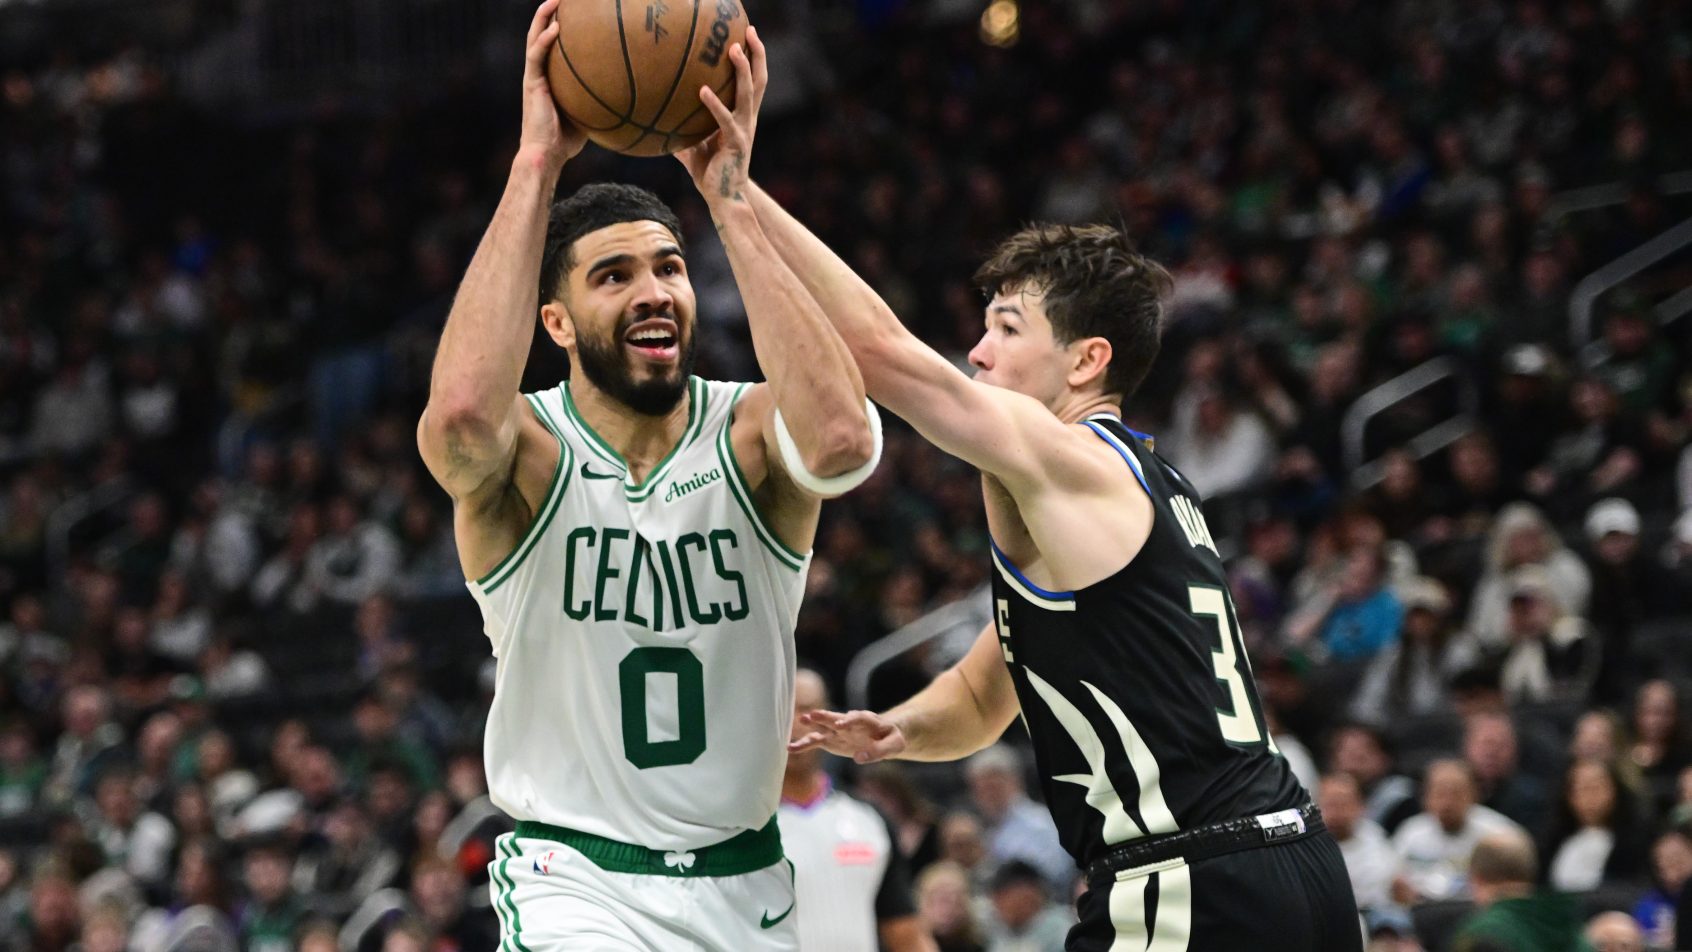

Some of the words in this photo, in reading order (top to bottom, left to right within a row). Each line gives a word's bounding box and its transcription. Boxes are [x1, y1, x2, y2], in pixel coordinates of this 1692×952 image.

[665, 468, 721, 503] Amica
[563, 526, 750, 632] CELTICS
[618, 646, 707, 770] 0
[1187, 582, 1279, 754] 3
